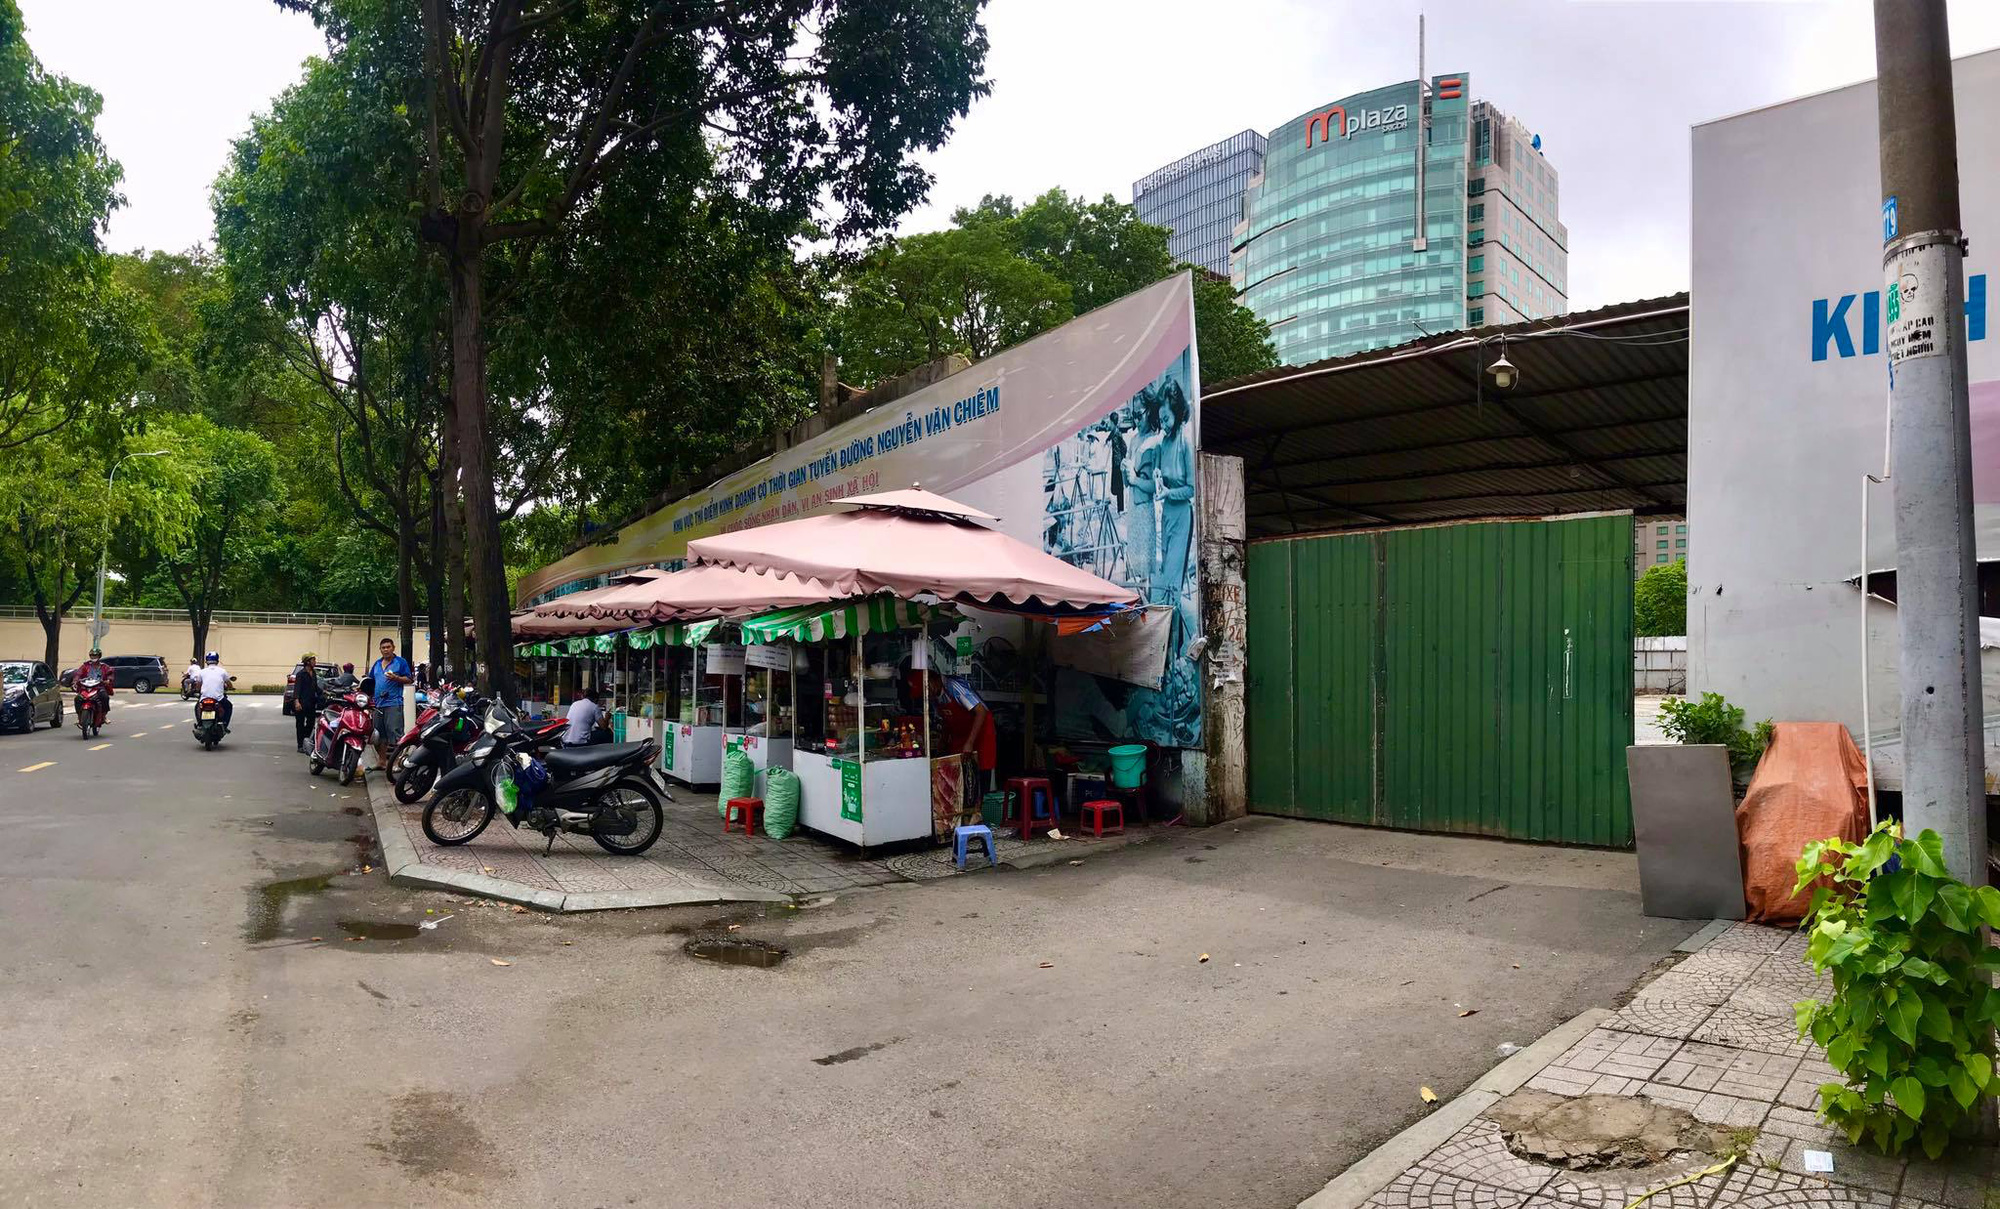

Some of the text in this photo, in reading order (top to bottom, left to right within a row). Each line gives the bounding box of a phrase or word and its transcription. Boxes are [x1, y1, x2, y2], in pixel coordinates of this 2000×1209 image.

[1812, 274, 1986, 361] KIH
[734, 486, 756, 511] DOANH
[788, 465, 807, 489] GIAN
[808, 448, 837, 481] TUYẾN
[840, 436, 874, 469] ĐƯỜNG
[877, 412, 922, 455] NGUYỄN
[925, 406, 951, 436] VĂN
[953, 387, 1000, 426] CHIÊM
[825, 484, 845, 502] SINH
[847, 475, 859, 497] XÃ
[862, 469, 879, 491] HỘI
